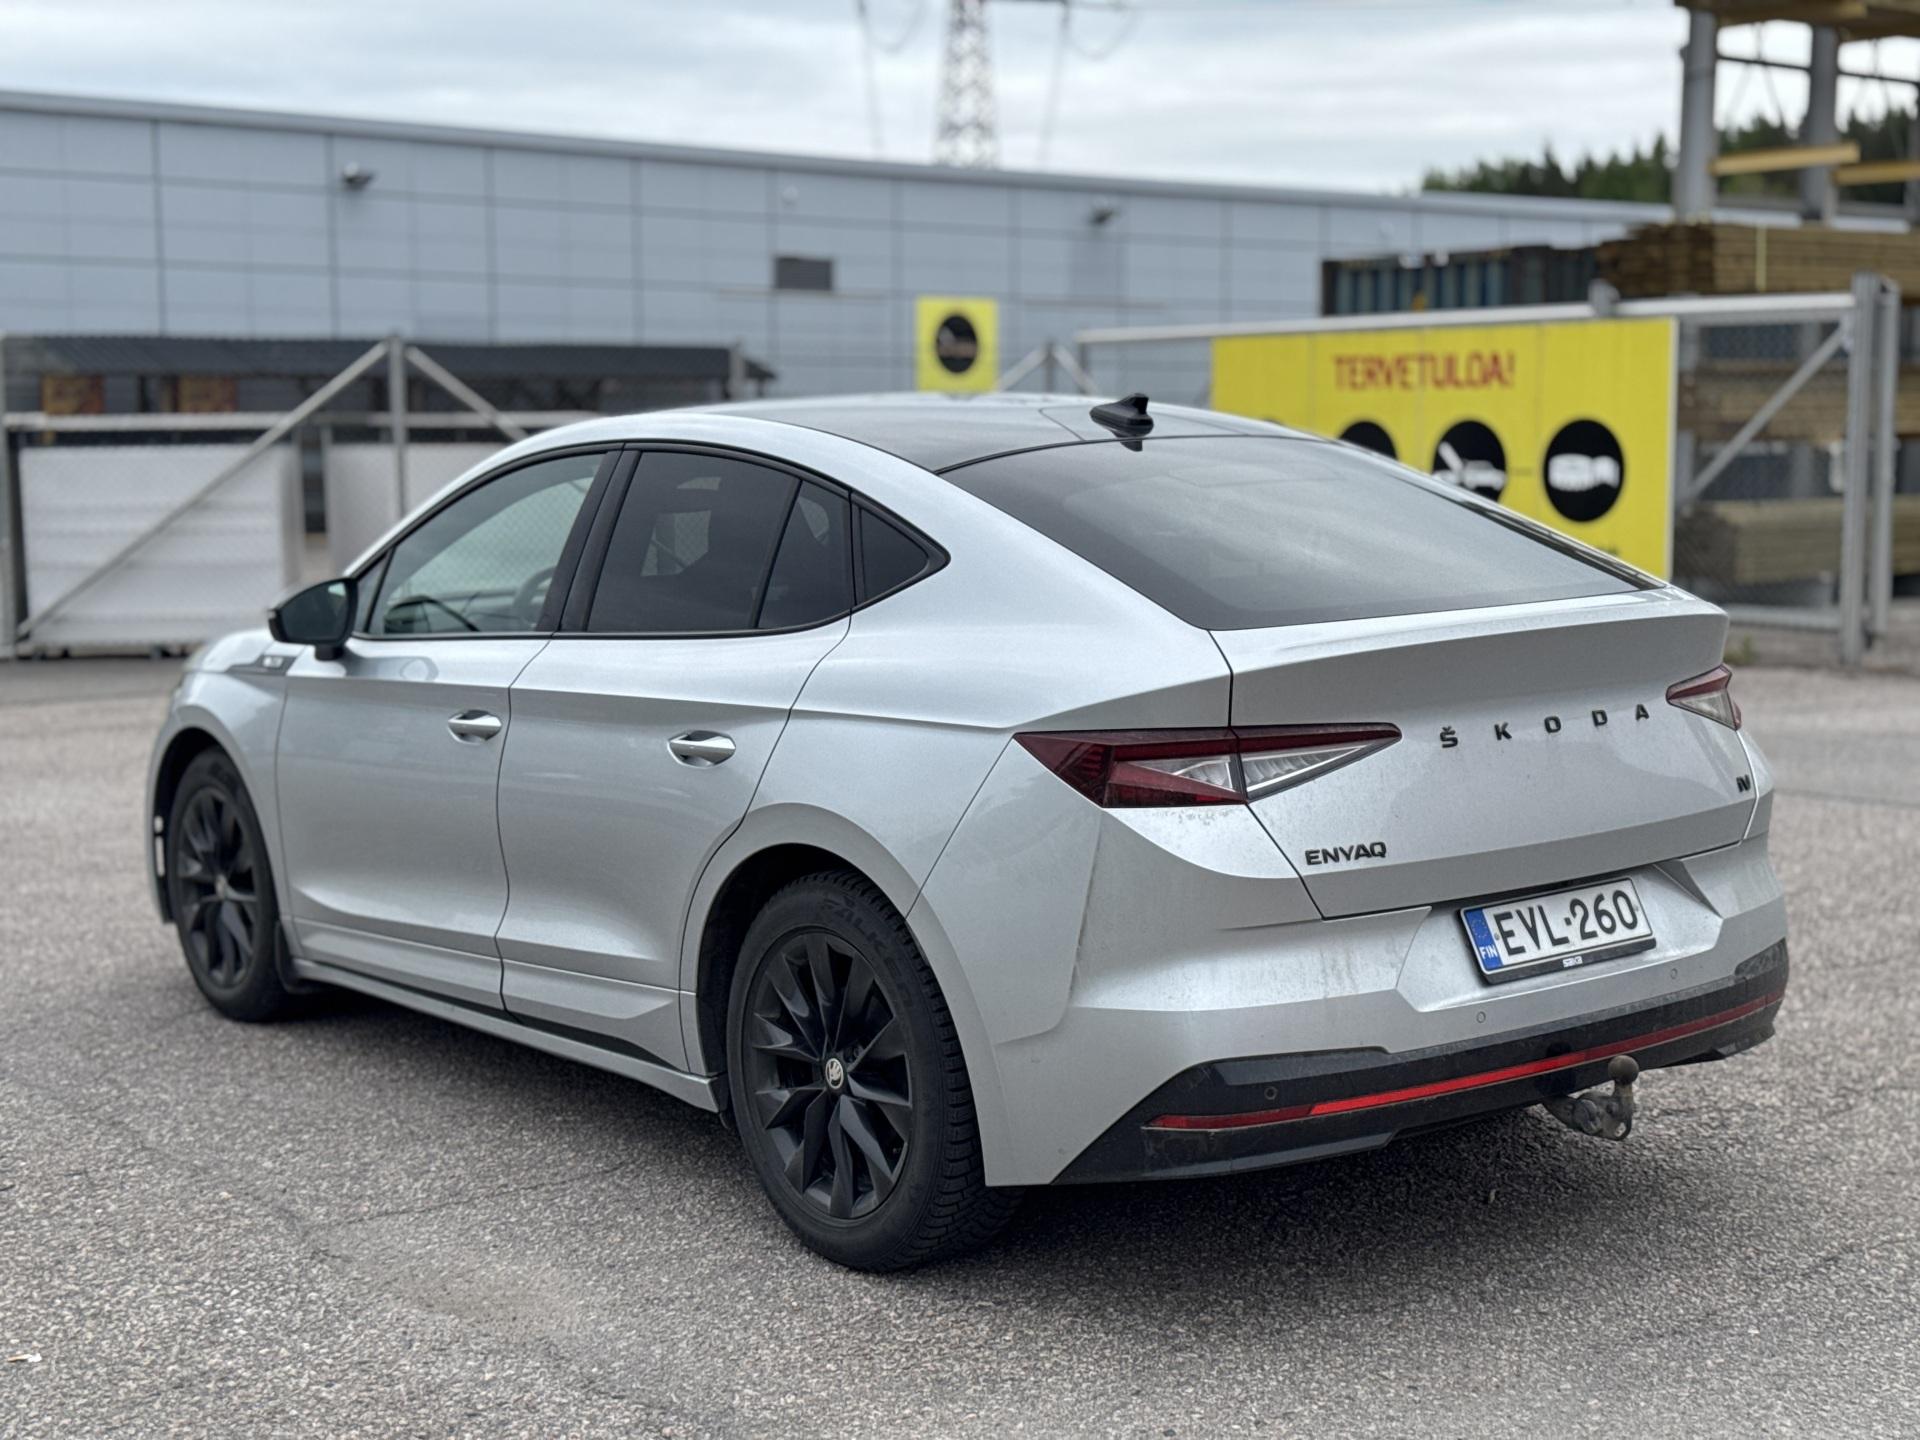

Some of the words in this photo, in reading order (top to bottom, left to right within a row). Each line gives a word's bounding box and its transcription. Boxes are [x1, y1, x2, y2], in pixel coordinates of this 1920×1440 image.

[1333, 352, 1516, 391] TERVETULOA!
[1439, 703, 1650, 749] ŠKODA
[1304, 842, 1387, 866] ENYAQ
[1494, 889, 1639, 956] EVL-260
[1479, 944, 1497, 960] FIN
